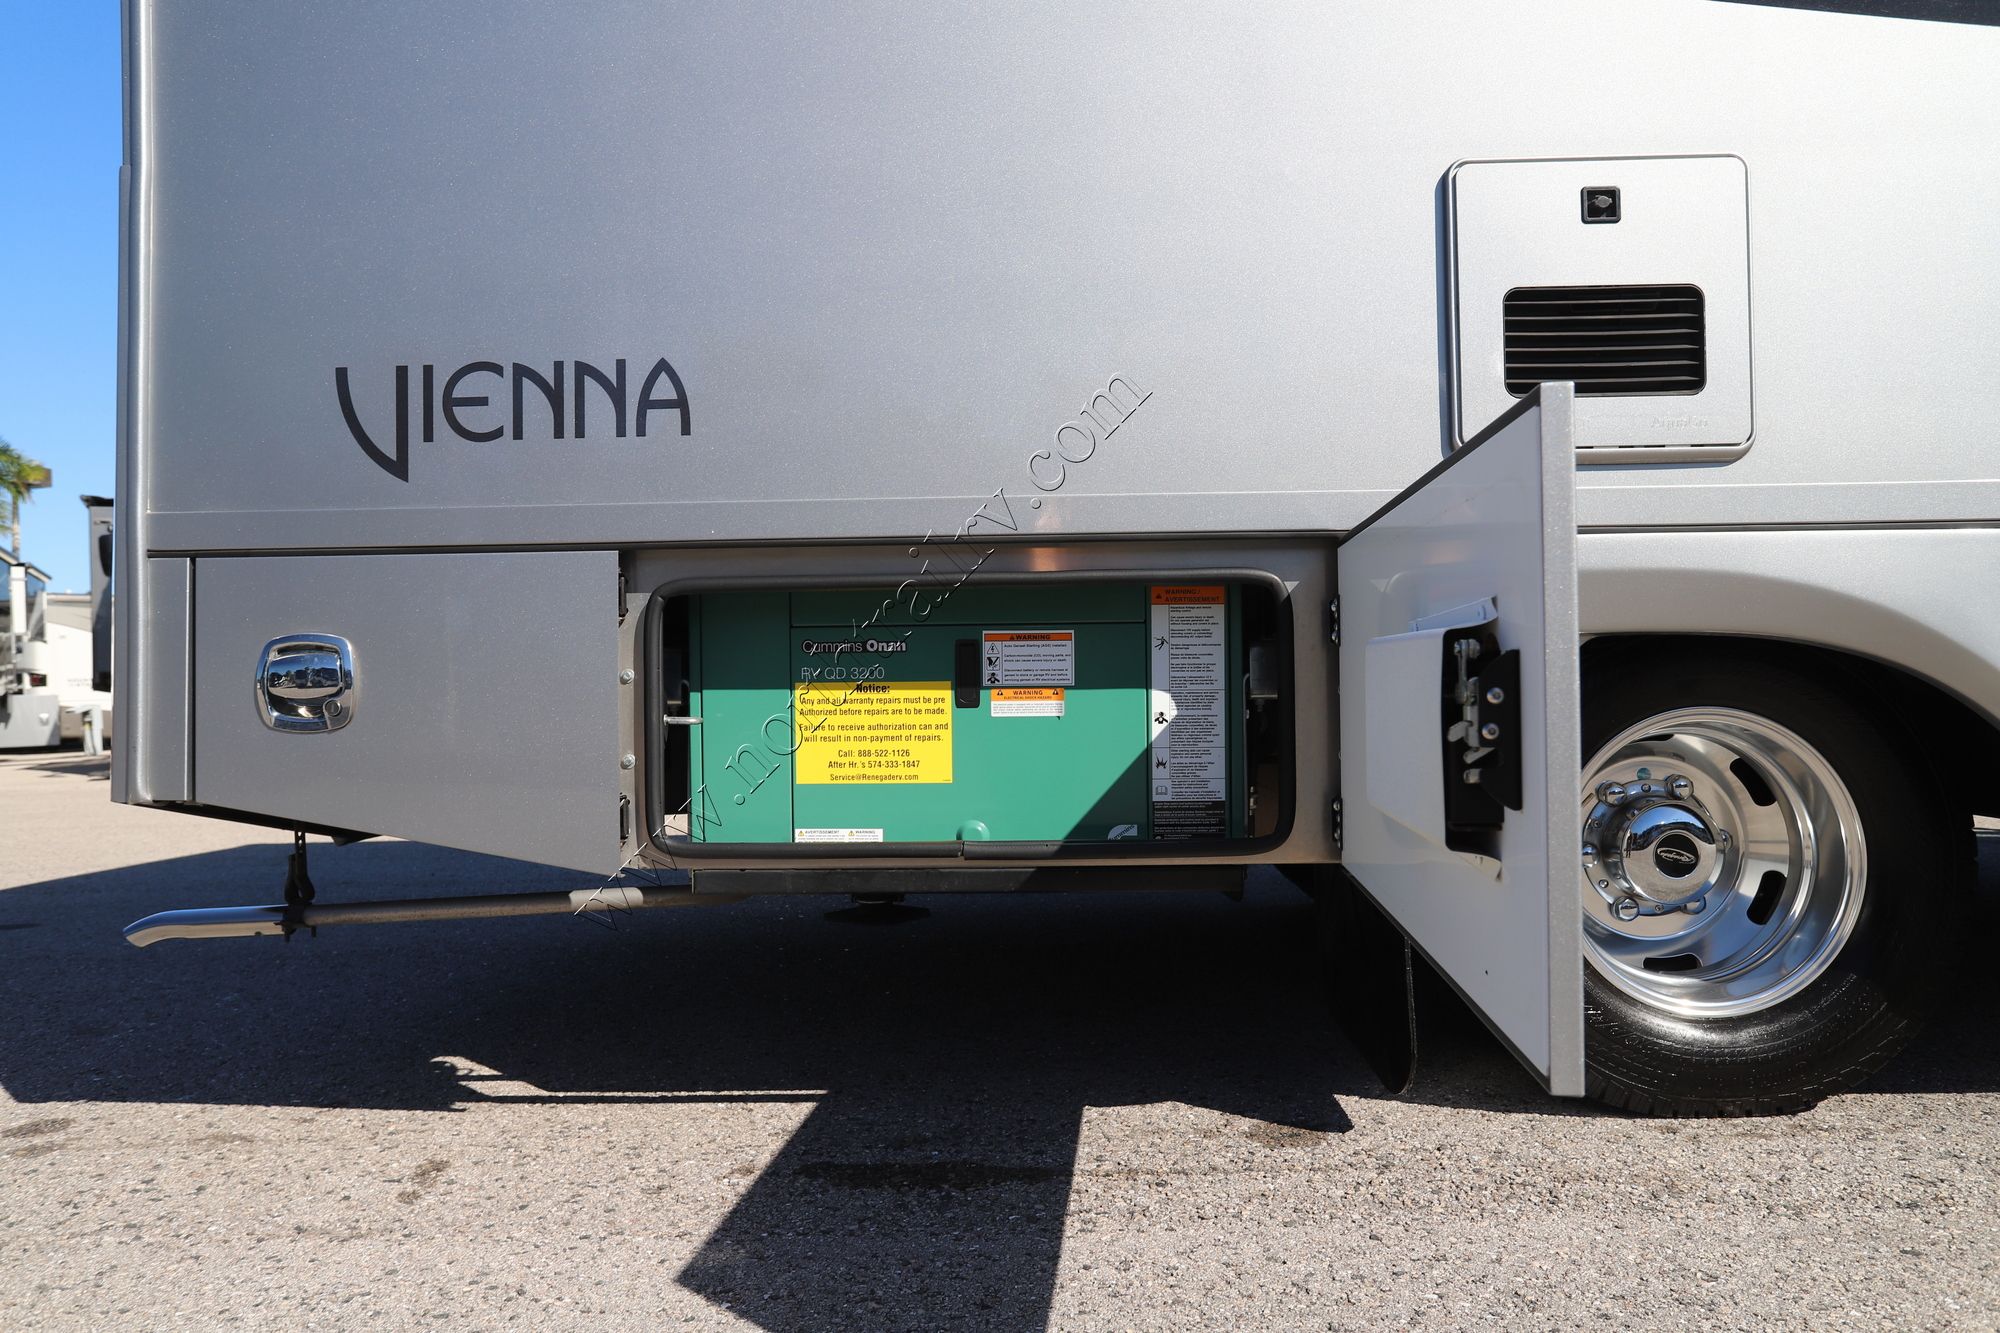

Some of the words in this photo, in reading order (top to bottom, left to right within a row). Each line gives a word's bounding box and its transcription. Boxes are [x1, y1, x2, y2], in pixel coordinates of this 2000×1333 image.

[335, 357, 691, 483] VIENNA
[802, 639, 863, 653] Cummins
[866, 639, 906, 653] Onan
[801, 667, 820, 680] RV
[824, 667, 846, 680] QD
[850, 667, 885, 680] 3200
[856, 683, 891, 694] Notice:
[801, 697, 815, 706] Any
[816, 697, 830, 706] and
[843, 697, 875, 706] warranty
[876, 697, 902, 706] repairs
[903, 697, 921, 706] must
[923, 697, 932, 706] be
[934, 697, 946, 706] pre
[800, 708, 837, 717] Authorized
[839, 708, 862, 717] before
[864, 708, 889, 717] repairs
[890, 708, 902, 717] are
[904, 708, 912, 717] to
[914, 708, 923, 717] be
[924, 708, 947, 717] made.
[799, 723, 826, 732] Failure
[828, 723, 836, 732] to
[837, 723, 865, 732] receive
[867, 723, 917, 732] authorization
[919, 723, 933, 732] can
[934, 723, 949, 732] and
[803, 734, 818, 743] will
[820, 734, 841, 743] result
[844, 734, 851, 743] in
[853, 734, 903, 743] non-payment
[905, 734, 912, 743] of
[914, 734, 944, 743] repairs.
[838, 749, 856, 758] Call:
[857, 749, 910, 758] 888-522-1126
[828, 760, 846, 769] After
[868, 760, 920, 769] 574-333-1847
[830, 773, 919, 782] Service@Renegaderv.com
